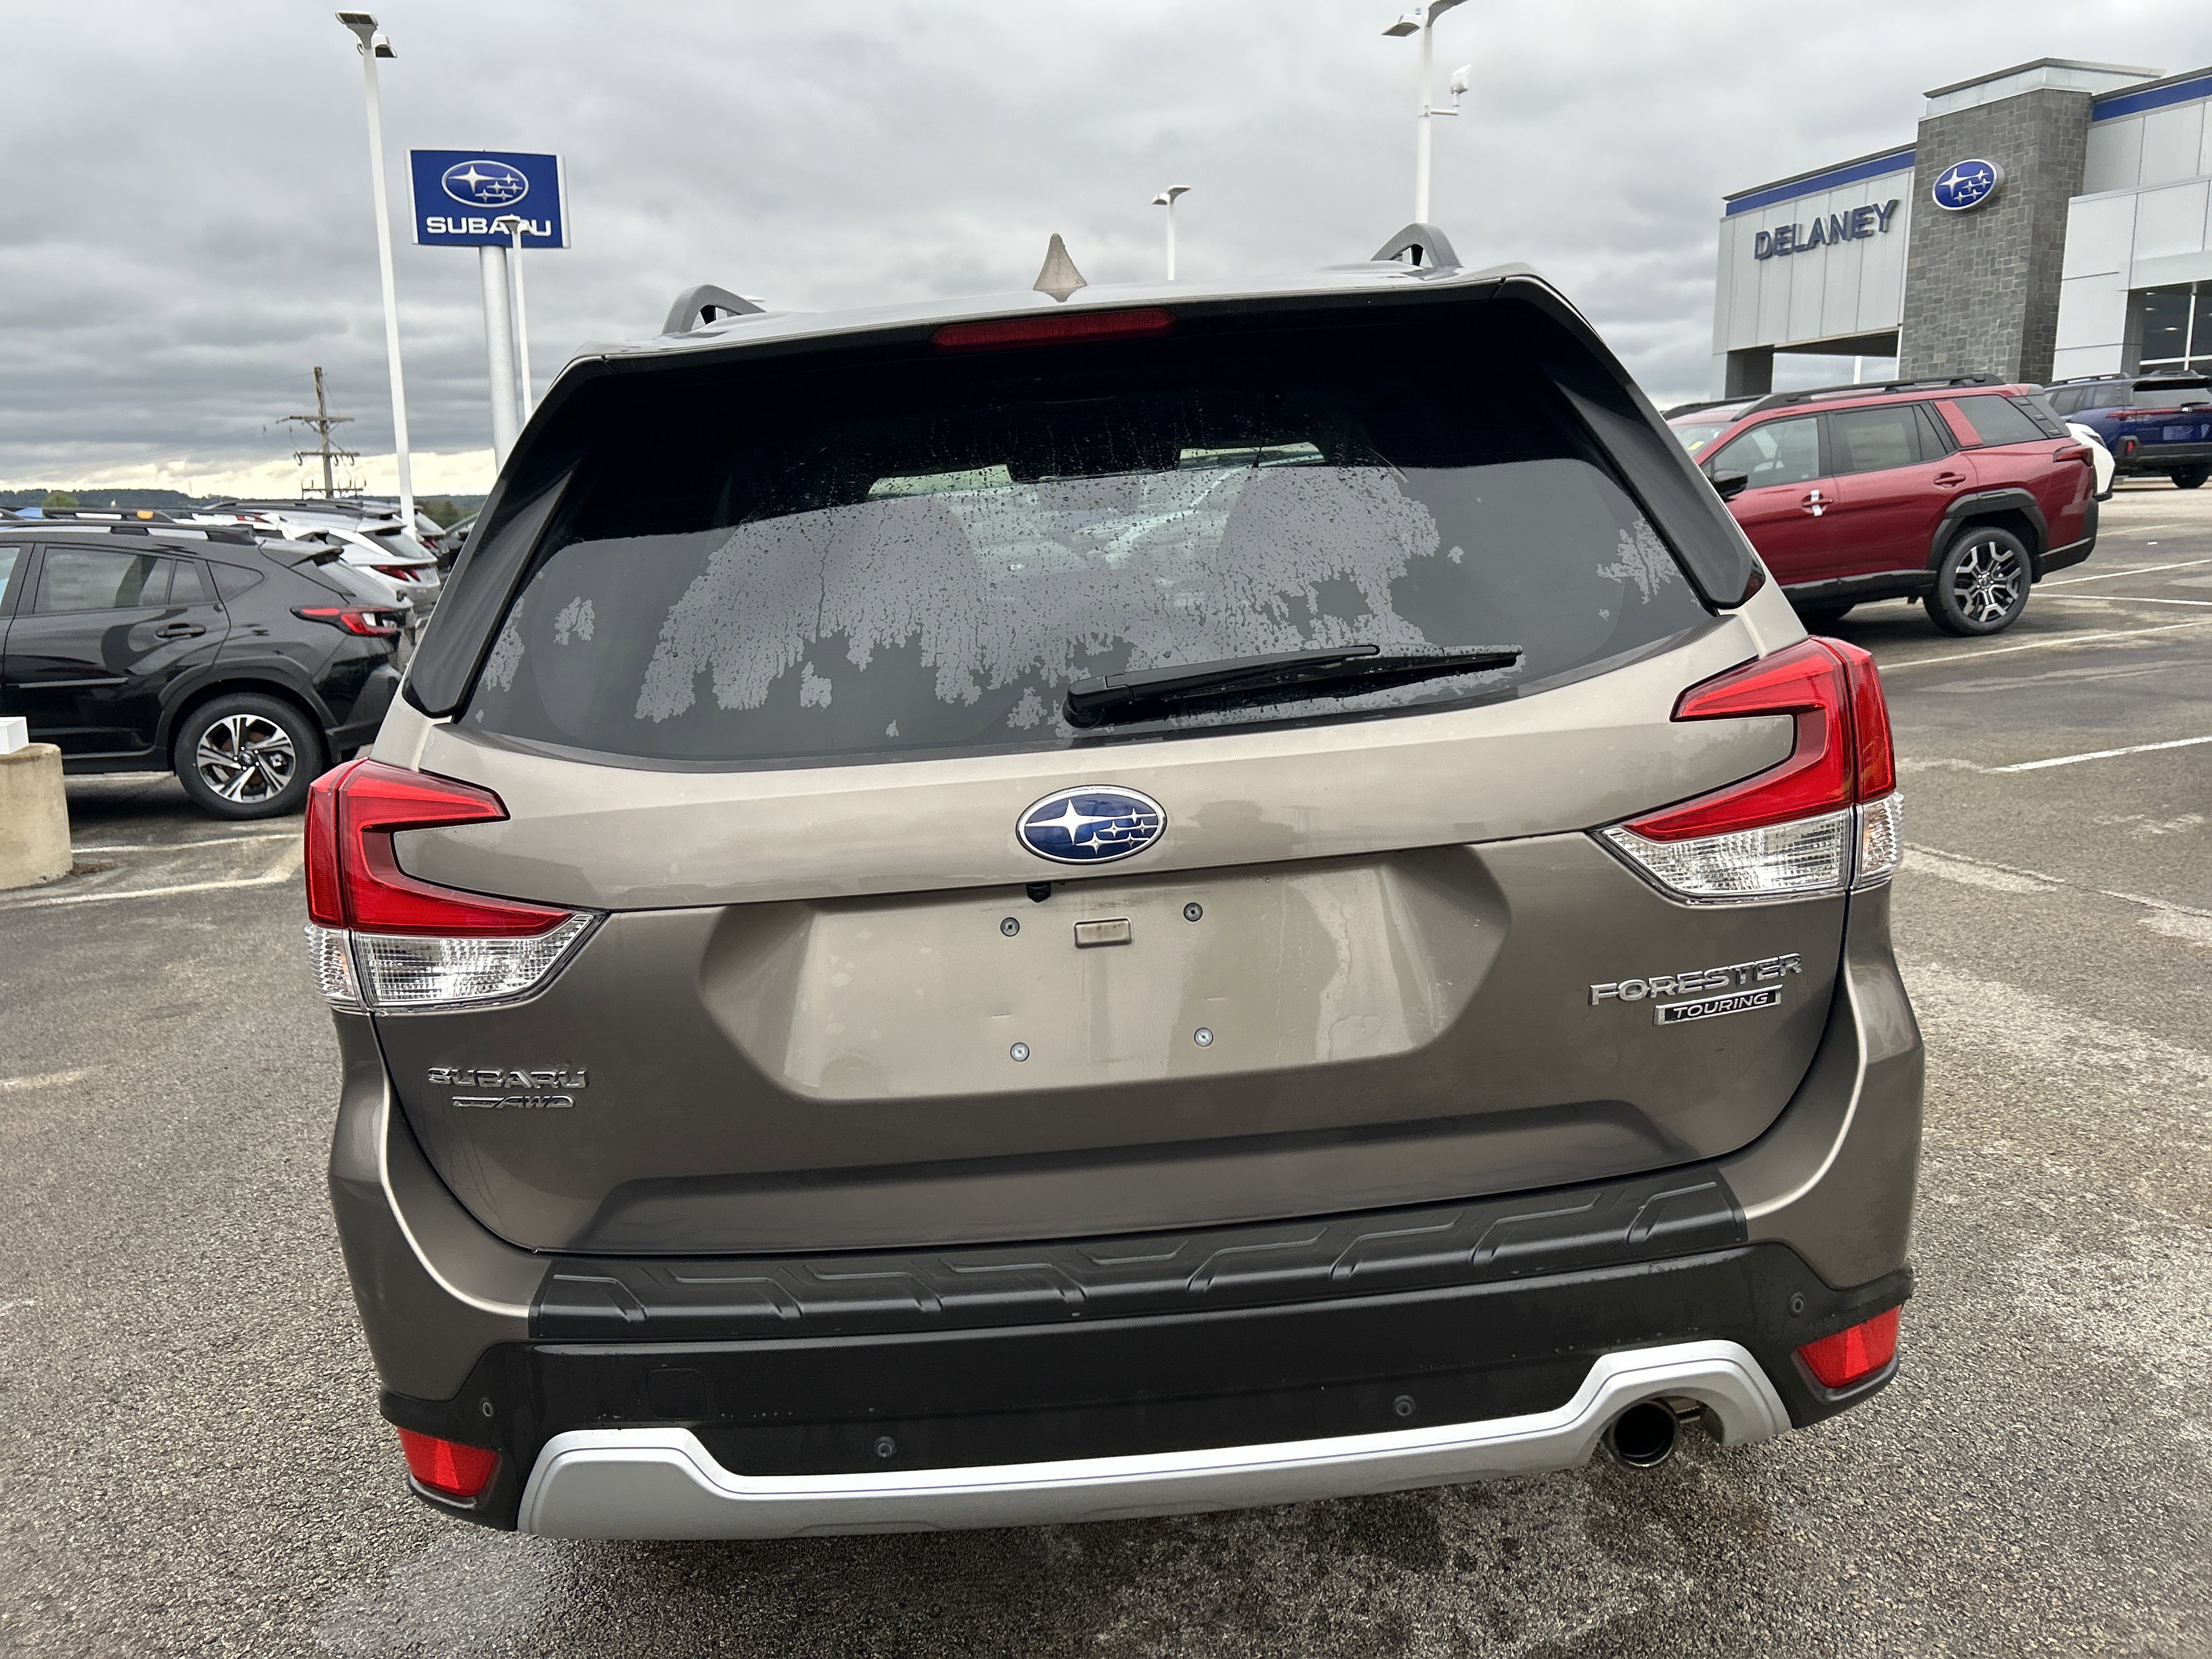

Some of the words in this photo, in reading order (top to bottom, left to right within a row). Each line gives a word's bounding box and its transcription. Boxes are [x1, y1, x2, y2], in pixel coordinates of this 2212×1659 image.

[426, 216, 551, 236] SUBAU
[1754, 199, 1899, 259] DELANEY
[1589, 952, 1803, 1006] FORESTER
[1673, 992, 1769, 1019] TOURING
[427, 1067, 588, 1089] SUBARU
[495, 1095, 575, 1109] AWD
